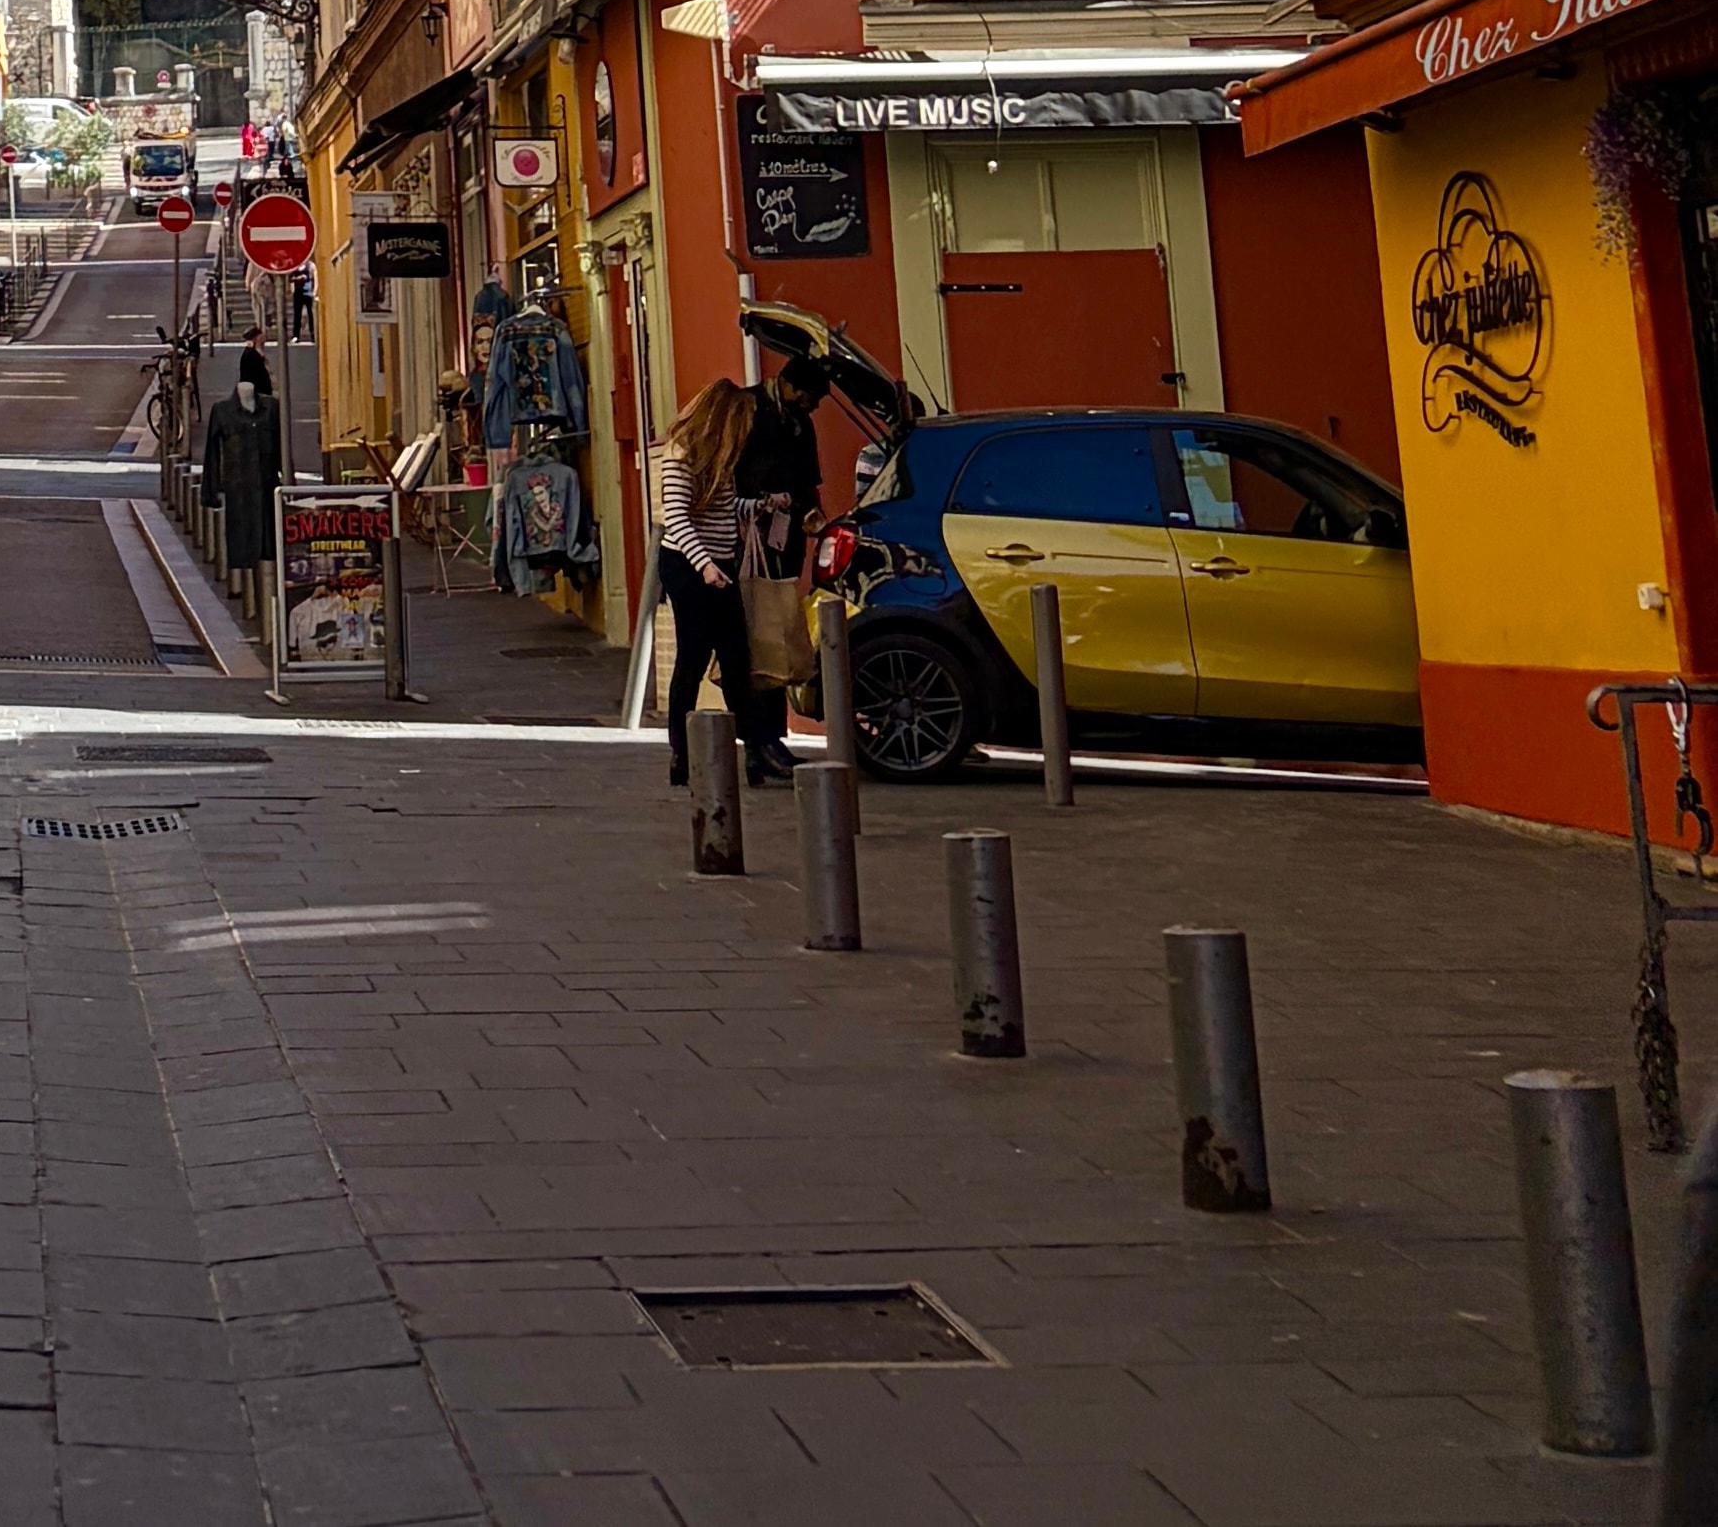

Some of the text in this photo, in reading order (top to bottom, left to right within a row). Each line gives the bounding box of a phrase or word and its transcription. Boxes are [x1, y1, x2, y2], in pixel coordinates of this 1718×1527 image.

[1415, 15, 1519, 83] Chez
[835, 96, 1027, 128] LIVE MUSIC
[750, 133, 815, 145] restaurant
[1419, 260, 1535, 366] chez juliette
[285, 511, 391, 544] SNAKERS
